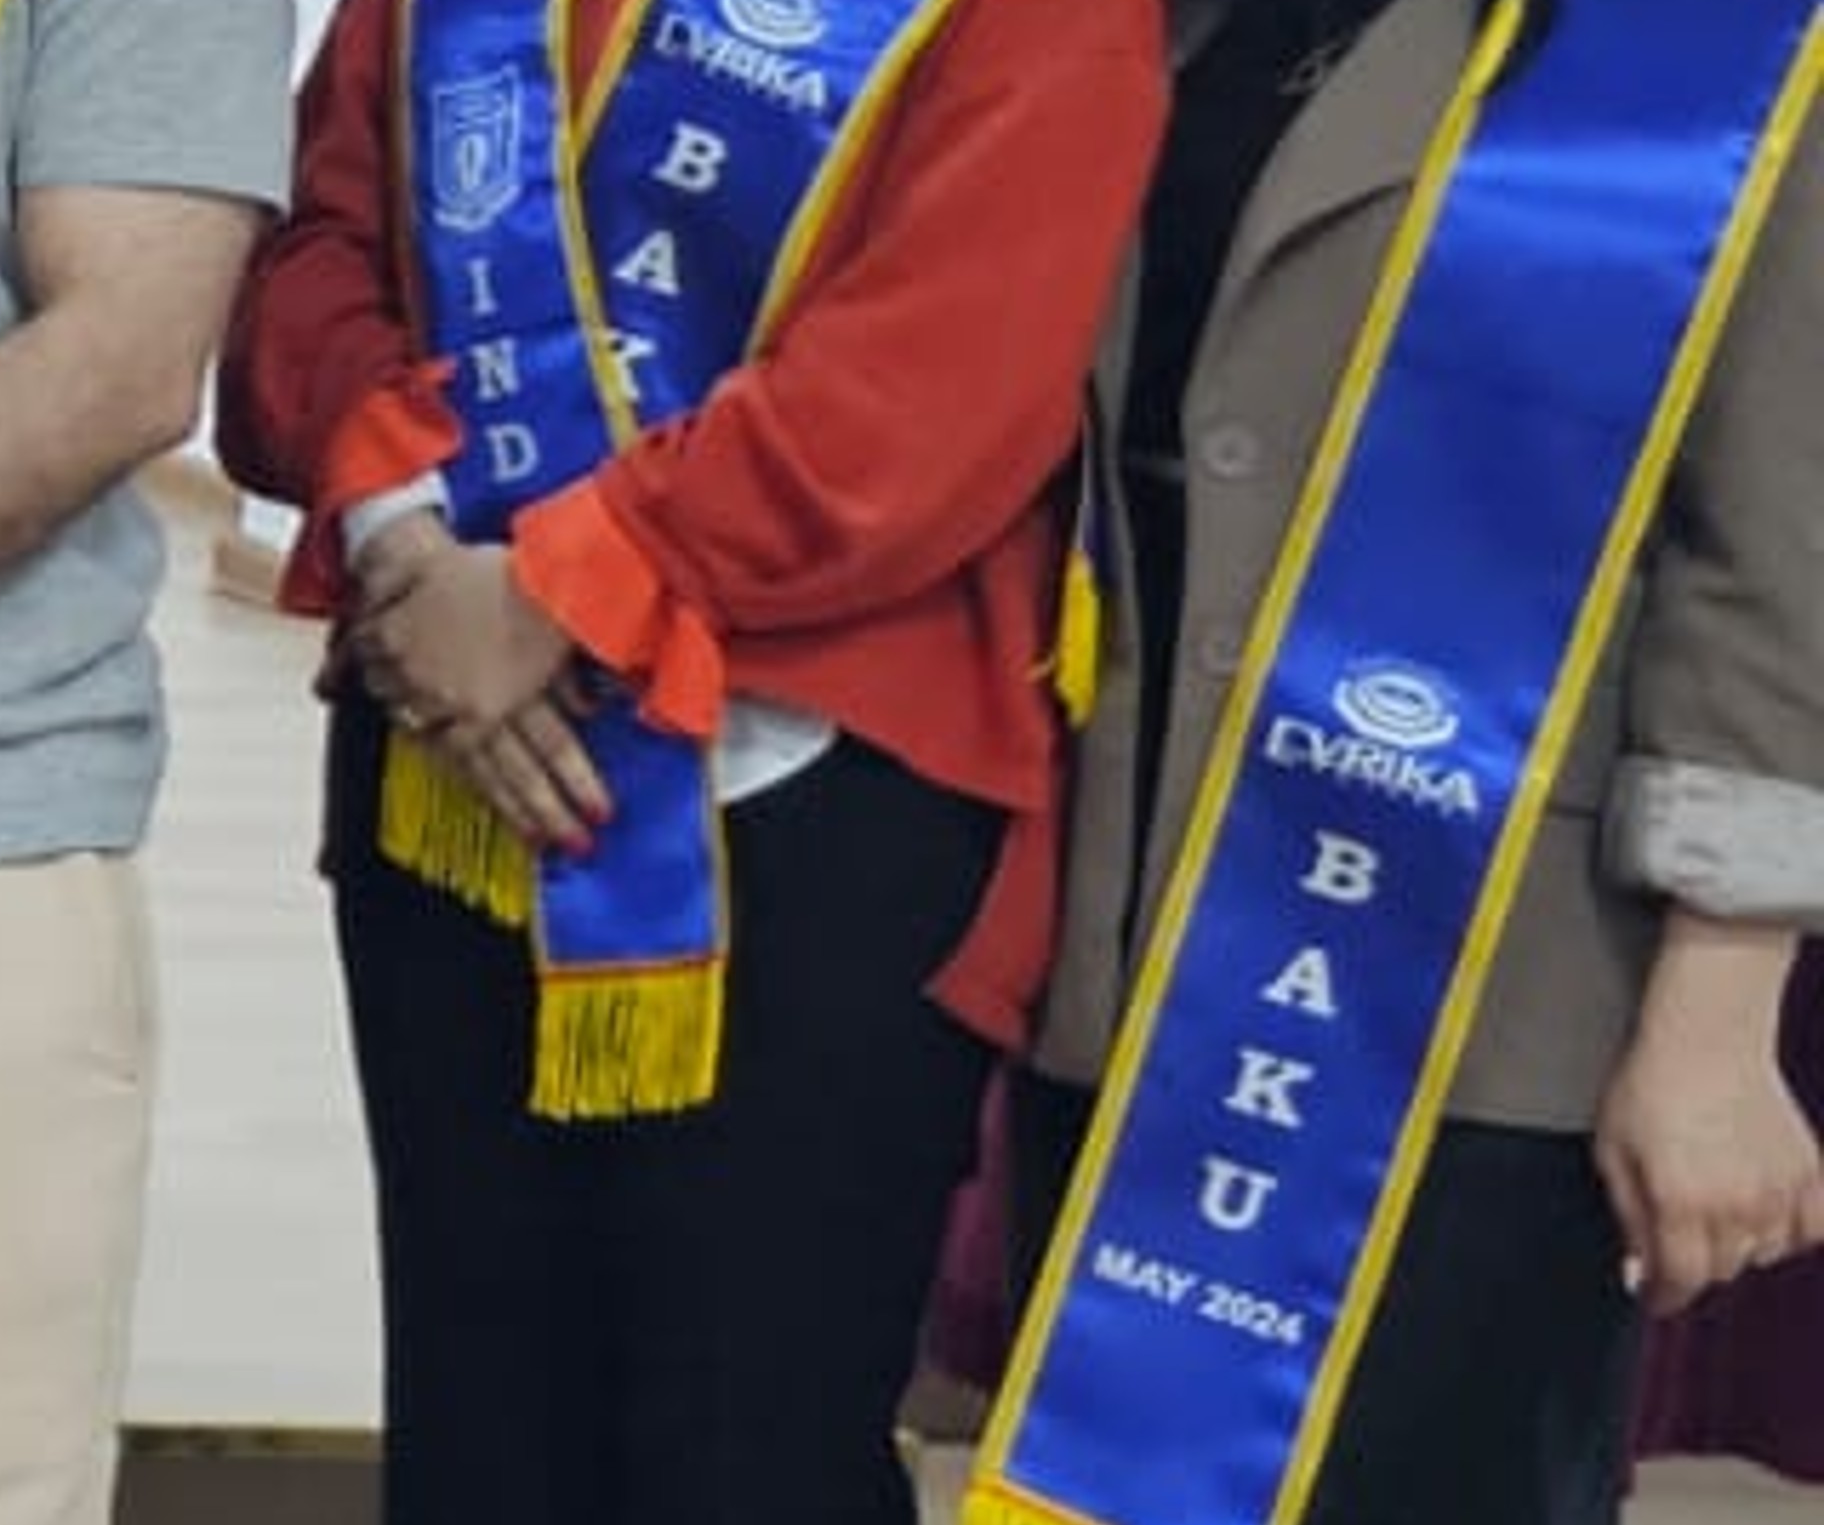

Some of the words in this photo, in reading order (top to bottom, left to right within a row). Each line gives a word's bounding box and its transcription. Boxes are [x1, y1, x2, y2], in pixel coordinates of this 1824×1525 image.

[1199, 830, 1377, 1231] BAKU
[1095, 1244, 1195, 1303] MAY
[1200, 1281, 1307, 1344] 2024
